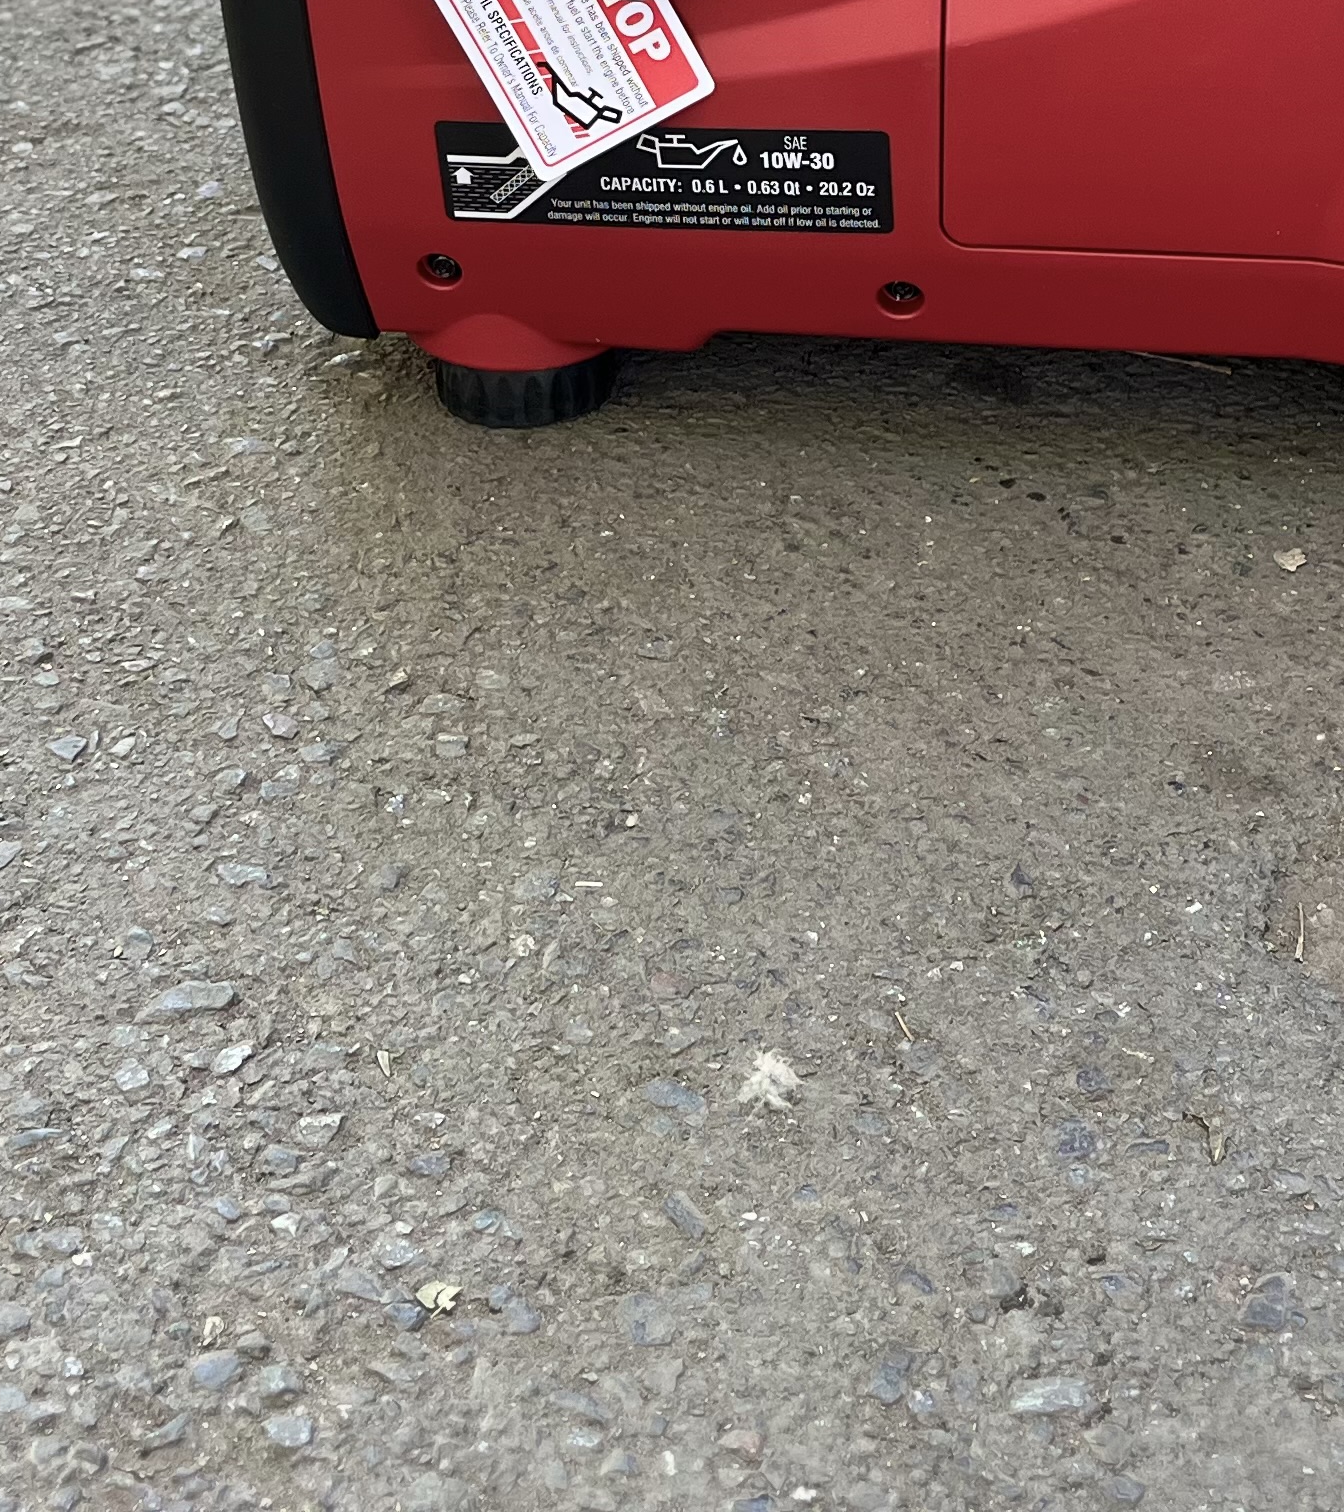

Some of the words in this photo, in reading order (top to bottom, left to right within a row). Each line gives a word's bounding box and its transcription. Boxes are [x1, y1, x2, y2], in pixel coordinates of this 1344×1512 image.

[574, 16, 585, 27] or
[474, 21, 493, 43] Refer
[579, 24, 597, 47] start
[486, 41, 500, 54] To
[584, 4, 600, 21] has
[594, 20, 612, 43] been
[605, 41, 631, 77] shipped
[625, 76, 648, 107] without
[591, 44, 606, 60] the
[597, 59, 619, 88] engine
[510, 83, 533, 112] Manual
[614, 86, 636, 115] before
[526, 110, 541, 126] For
[532, 123, 559, 159] Capacity
[783, 135, 807, 149] SAE
[759, 150, 835, 170] 10W-30
[599, 176, 682, 193] CAPACITY:
[691, 179, 714, 193] 0.6
[718, 180, 728, 193] L
[746, 179, 779, 195] 0.63
[783, 180, 800, 195] Qt
[818, 181, 852, 196] 20.2
[855, 181, 875, 196] Oz
[550, 198, 572, 207] Your
[574, 199, 591, 208] unit
[593, 199, 609, 208] has
[611, 200, 633, 209] been
[635, 201, 670, 213] shipped
[672, 202, 706, 212] without
[708, 203, 738, 214] engine
[756, 204, 775, 213] Add
[777, 204, 788, 214] oil
[790, 205, 811, 216] prior
[813, 206, 823, 214] to
[825, 205, 859, 217] starting
[547, 210, 582, 221] damage
[584, 212, 600, 221] will
[632, 214, 662, 223] Engine
[665, 215, 679, 223] will
[682, 216, 697, 224] not
[699, 215, 719, 224] start
[734, 215, 748, 224] will
[751, 216, 771, 225] shut
[773, 216, 786, 225] off
[788, 217, 794, 225] if
[796, 217, 813, 226] low
[815, 218, 826, 226] oil
[828, 218, 837, 227] is
[839, 218, 881, 229] detected.
